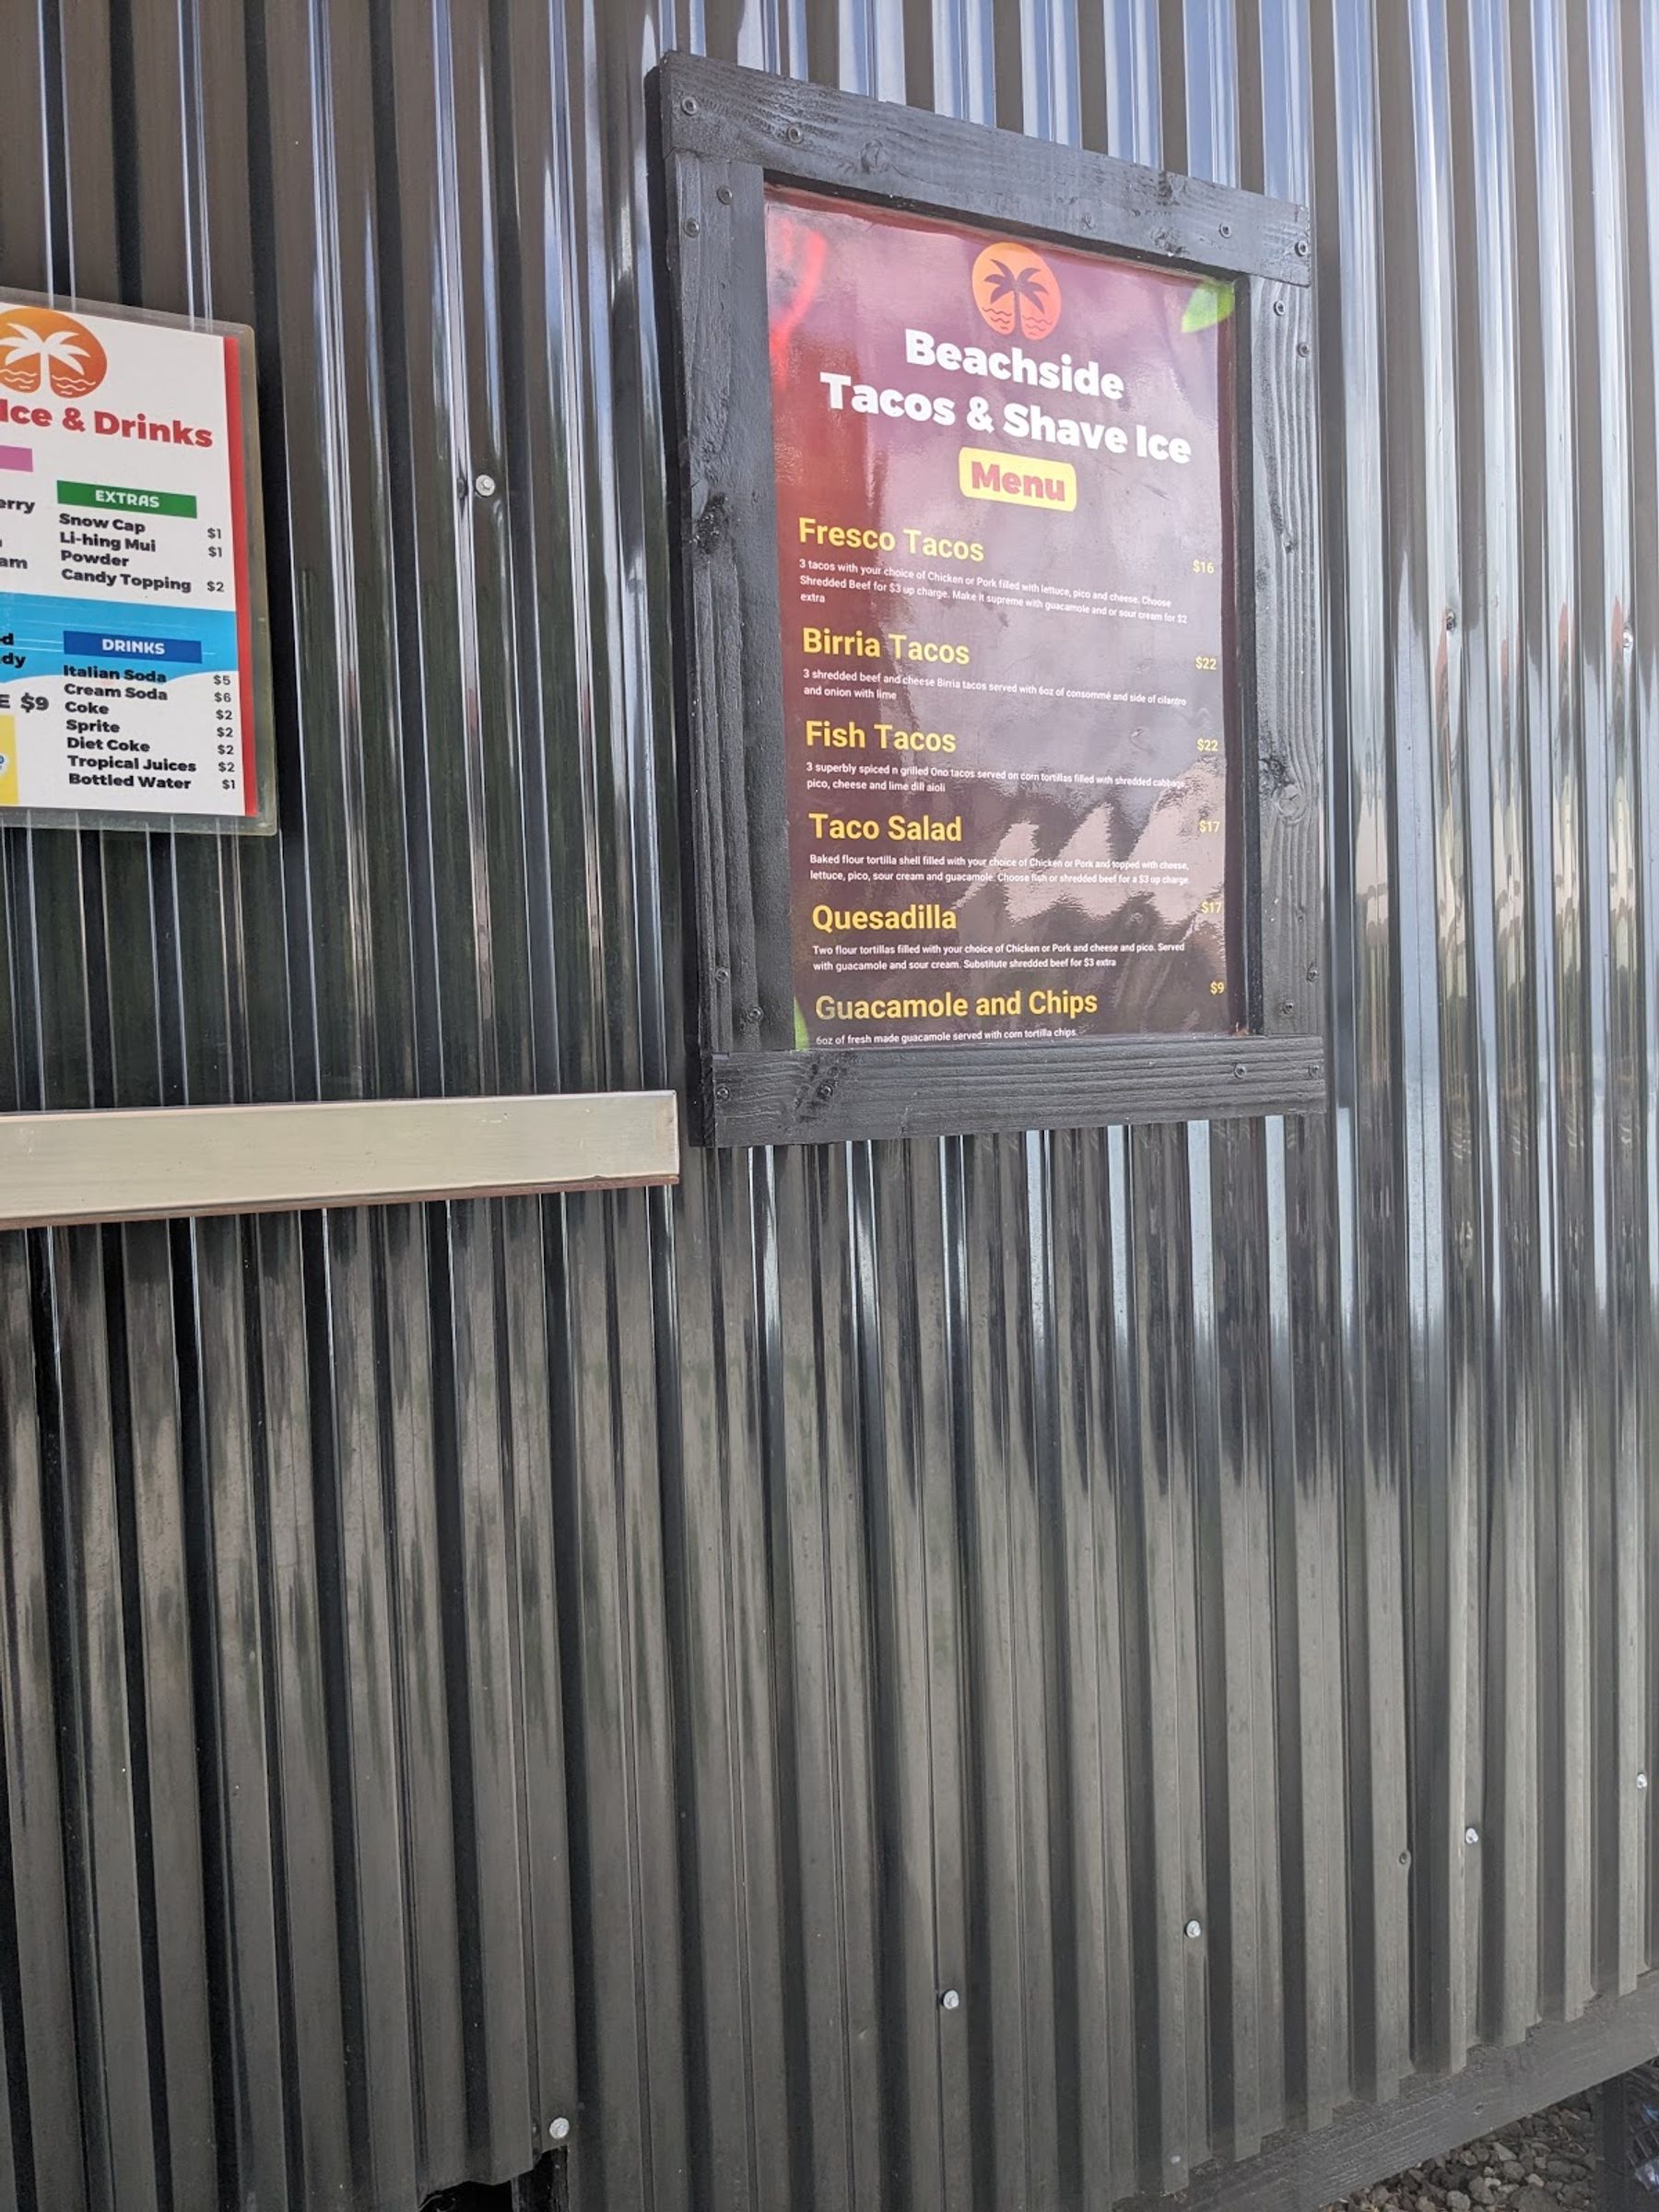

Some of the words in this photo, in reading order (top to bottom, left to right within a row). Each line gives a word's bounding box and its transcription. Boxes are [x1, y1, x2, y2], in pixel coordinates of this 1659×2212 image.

[904, 328, 1125, 400] Beachside
[0, 398, 52, 427] Ice
[62, 407, 86, 432] &
[94, 410, 213, 448] Drinks
[819, 371, 956, 426] Tacos
[967, 395, 994, 433] &
[1003, 401, 1128, 454] Shave
[1136, 426, 1192, 464] Ice
[971, 462, 1065, 501] Menu
[95, 489, 160, 508] EXTRAS
[59, 512, 109, 529] Snow
[112, 519, 146, 534] Cap
[208, 527, 221, 540] $1
[60, 531, 122, 550] Li-hing
[125, 538, 156, 552] Mui
[208, 546, 222, 559] $1
[798, 517, 896, 551] Fresco
[903, 527, 984, 562] Tacos
[61, 549, 129, 568] Powder
[1193, 559, 1215, 574] $16
[799, 559, 806, 568] 3
[808, 560, 835, 571] tacos
[837, 562, 858, 572] with
[860, 566, 881, 578] your
[883, 567, 914, 579] choice
[916, 571, 926, 580] of
[927, 571, 963, 583] Chicken
[61, 569, 116, 586] Candy
[120, 573, 192, 594] Topping
[206, 581, 225, 592] $2
[799, 575, 847, 588] Shredded
[849, 581, 871, 590] Beef
[874, 582, 887, 592] for
[889, 582, 901, 594] $3
[903, 586, 914, 595] up
[917, 586, 950, 599] charge.
[800, 594, 825, 603] extra
[101, 639, 166, 654] DRINKS
[803, 627, 880, 657] Birria
[888, 633, 970, 665] Tacos
[1195, 655, 1217, 670] $22
[63, 665, 120, 680] Italian
[124, 669, 167, 683] Soda
[214, 675, 230, 686] $5
[804, 668, 809, 678] 3
[812, 669, 857, 682] shredded
[859, 672, 881, 683] beef
[883, 674, 900, 684] and
[902, 677, 935, 687] cheese
[937, 677, 960, 688] Birria
[962, 680, 986, 690] tacos
[988, 681, 1018, 693] served
[65, 683, 124, 699] Cream
[128, 688, 168, 700] Soda
[214, 692, 230, 704] $6
[804, 685, 821, 696] and
[824, 687, 852, 697] onion
[854, 688, 875, 699] with
[877, 688, 897, 700] lime
[20, 693, 49, 712] $9
[65, 701, 109, 715] Coke
[216, 710, 232, 721] $2
[66, 719, 120, 734] Sprite
[218, 727, 233, 738] $2
[806, 720, 865, 747] Fish
[874, 724, 956, 753] Tacos
[66, 737, 103, 750] Diet
[107, 739, 149, 752] Coke
[218, 745, 234, 756] $2
[1197, 738, 1218, 751] $22
[68, 755, 139, 771] Tropical
[143, 759, 196, 772] Juices
[218, 762, 234, 773] $2
[806, 762, 812, 771] 3
[816, 762, 857, 775] superbly
[859, 764, 889, 775] spiced
[900, 766, 928, 777] grilled
[931, 767, 948, 776] Ono
[950, 769, 975, 778] tacos
[977, 770, 1006, 780] served
[69, 772, 135, 787] Bottled
[138, 775, 192, 789] Water
[222, 780, 235, 791] $1
[806, 779, 830, 790] pico,
[832, 779, 866, 790] cheese
[869, 781, 887, 791] and
[888, 781, 909, 791] lime
[912, 782, 924, 792] dill
[927, 782, 946, 792] aioli
[808, 813, 880, 840] Taco
[888, 814, 962, 841] Salad
[1199, 820, 1220, 833] $17
[810, 854, 840, 865] Baked
[842, 854, 864, 865] flour
[866, 854, 897, 865] tortilla
[900, 855, 921, 865] shell
[923, 856, 945, 865] filled
[947, 856, 966, 866] with
[968, 858, 986, 867] your
[810, 870, 845, 881] lettuce,
[848, 871, 871, 881] pico,
[873, 873, 893, 881] sour
[896, 873, 924, 881] cream
[926, 871, 943, 881] and
[1201, 901, 1221, 914] $17
[812, 904, 957, 933] Quesadilla
[813, 946, 832, 955] Two
[835, 945, 857, 955] flour
[859, 945, 895, 955] tortillas
[897, 945, 920, 954] filled
[922, 945, 942, 954] with
[944, 946, 962, 955] your
[964, 944, 993, 954] choice
[994, 944, 1004, 953] of
[1006, 943, 1040, 952] Chicken
[1041, 944, 1051, 952] or
[1053, 943, 1071, 952] Pork
[1073, 943, 1088, 952] and
[1090, 944, 1118, 952] cheese
[1120, 943, 1135, 952] and
[1137, 943, 1155, 953] pico.
[1158, 942, 1184, 952] Served
[813, 961, 833, 971] with
[836, 960, 888, 972] guacamole
[889, 959, 906, 970] and
[909, 960, 929, 969] sour
[931, 960, 961, 969] cream.
[963, 959, 1007, 968] Substitute
[1009, 958, 1048, 968] shredded
[1050, 958, 1068, 967] beef
[1070, 958, 1081, 967] for
[1084, 958, 1094, 967] $3
[1096, 958, 1116, 967] extra
[1210, 982, 1225, 994] $9
[816, 991, 968, 1020] Guacamole
[975, 990, 1021, 1016] and
[1029, 989, 1098, 1018] Chips
[835, 1034, 845, 1044] of
[847, 1034, 872, 1043] fresh
[874, 1033, 899, 1043] made
[901, 1031, 950, 1044] guacamole
[953, 1030, 982, 1041] served
[984, 1030, 1002, 1039] with
[1025, 1030, 1053, 1038] tortilla
[1054, 1028, 1077, 1038] chips.
